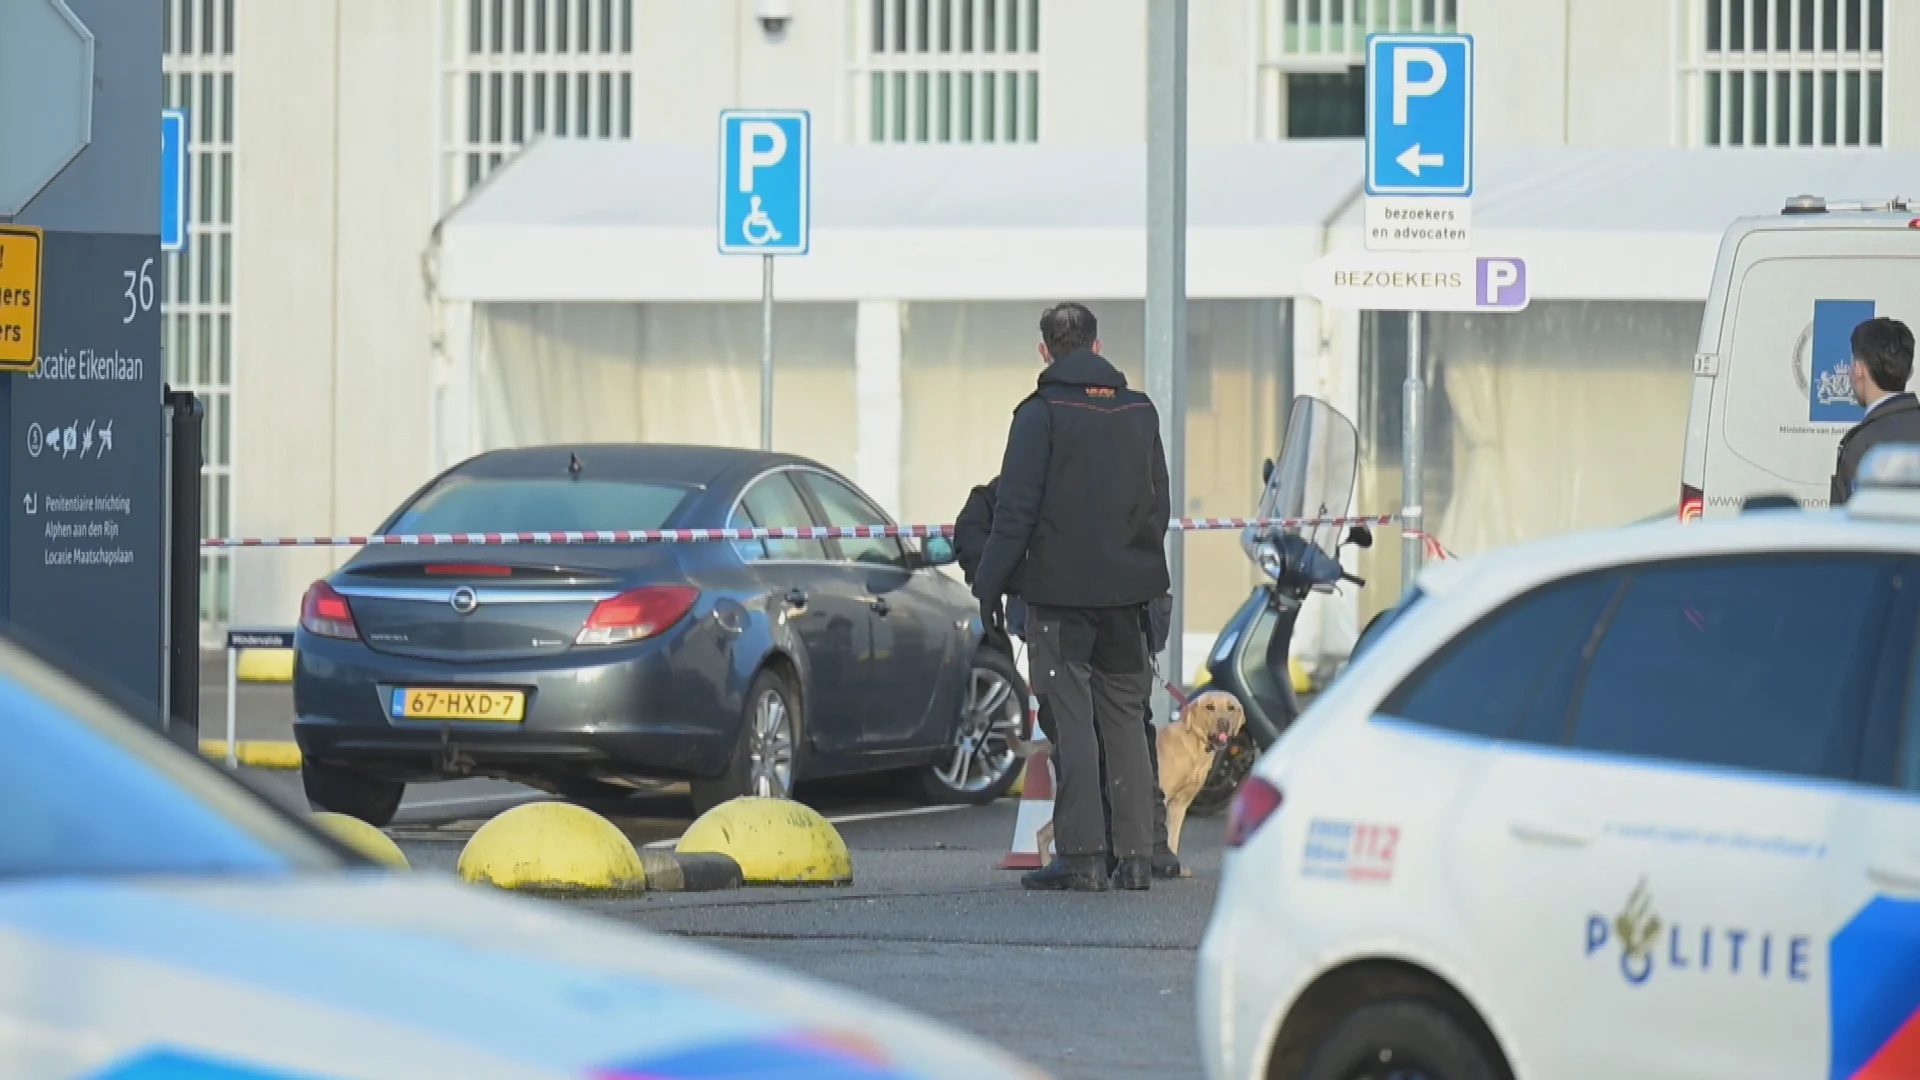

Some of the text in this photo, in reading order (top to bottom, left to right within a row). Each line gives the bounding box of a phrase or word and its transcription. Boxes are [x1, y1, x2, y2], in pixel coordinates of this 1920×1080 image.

[1393, 46, 1448, 126] P
[739, 120, 788, 193] P
[1384, 206, 1455, 221] bezoekers
[1372, 226, 1466, 240] en advocaten
[123, 258, 154, 324] 36
[1334, 260, 1518, 304] BEZOEKERS P
[79, 348, 143, 381] Eikenlaan
[45, 493, 131, 515] Penitentiaire Inrichting
[45, 520, 119, 542] Alphen aan den Rijn
[44, 548, 73, 565] Locatie
[411, 692, 515, 716] 67-HXD-7
[1352, 822, 1402, 862] 112
[1585, 905, 1814, 986] POLITIE
